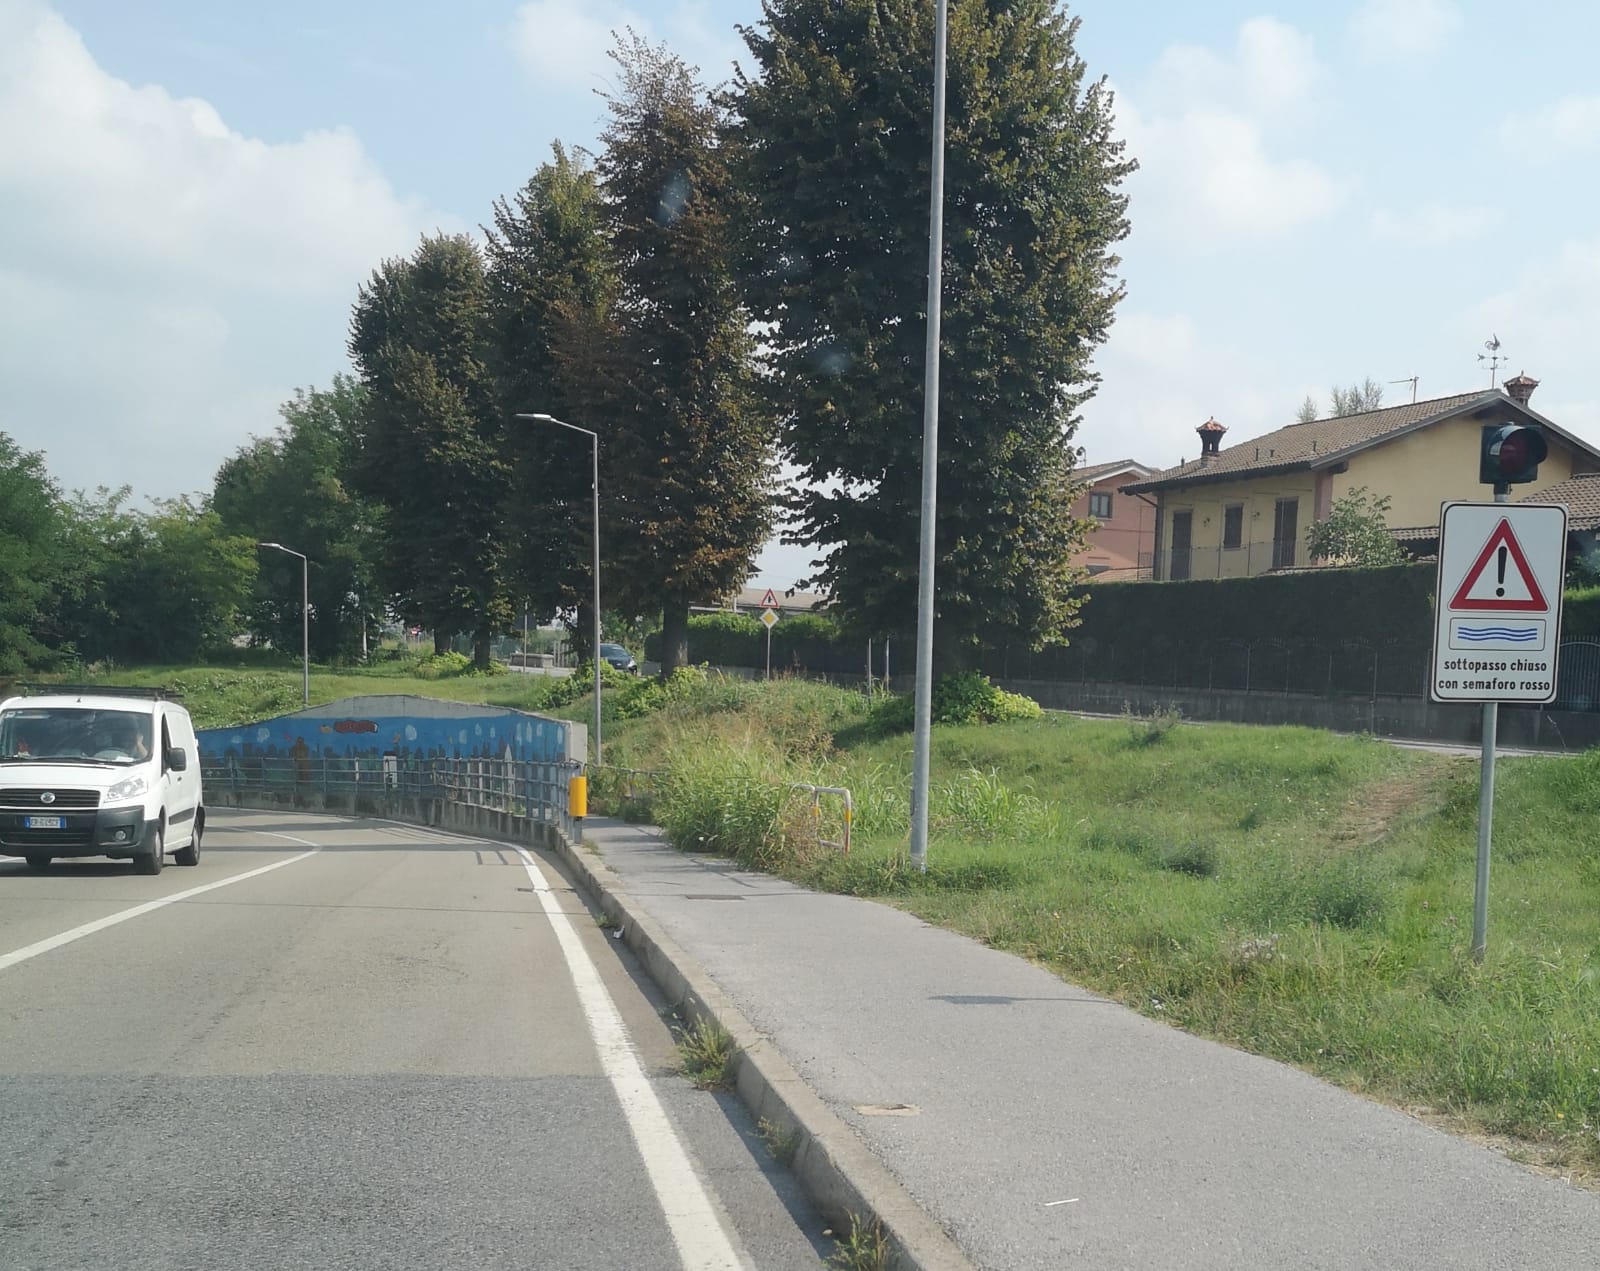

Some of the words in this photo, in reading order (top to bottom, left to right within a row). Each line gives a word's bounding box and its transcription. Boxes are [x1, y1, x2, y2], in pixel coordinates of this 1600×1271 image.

[1444, 658, 1507, 673] sottopasso
[1510, 659, 1547, 671] chiuso
[1438, 680, 1458, 689] con
[1462, 678, 1516, 690] semaforo
[1520, 681, 1550, 690] rosso
